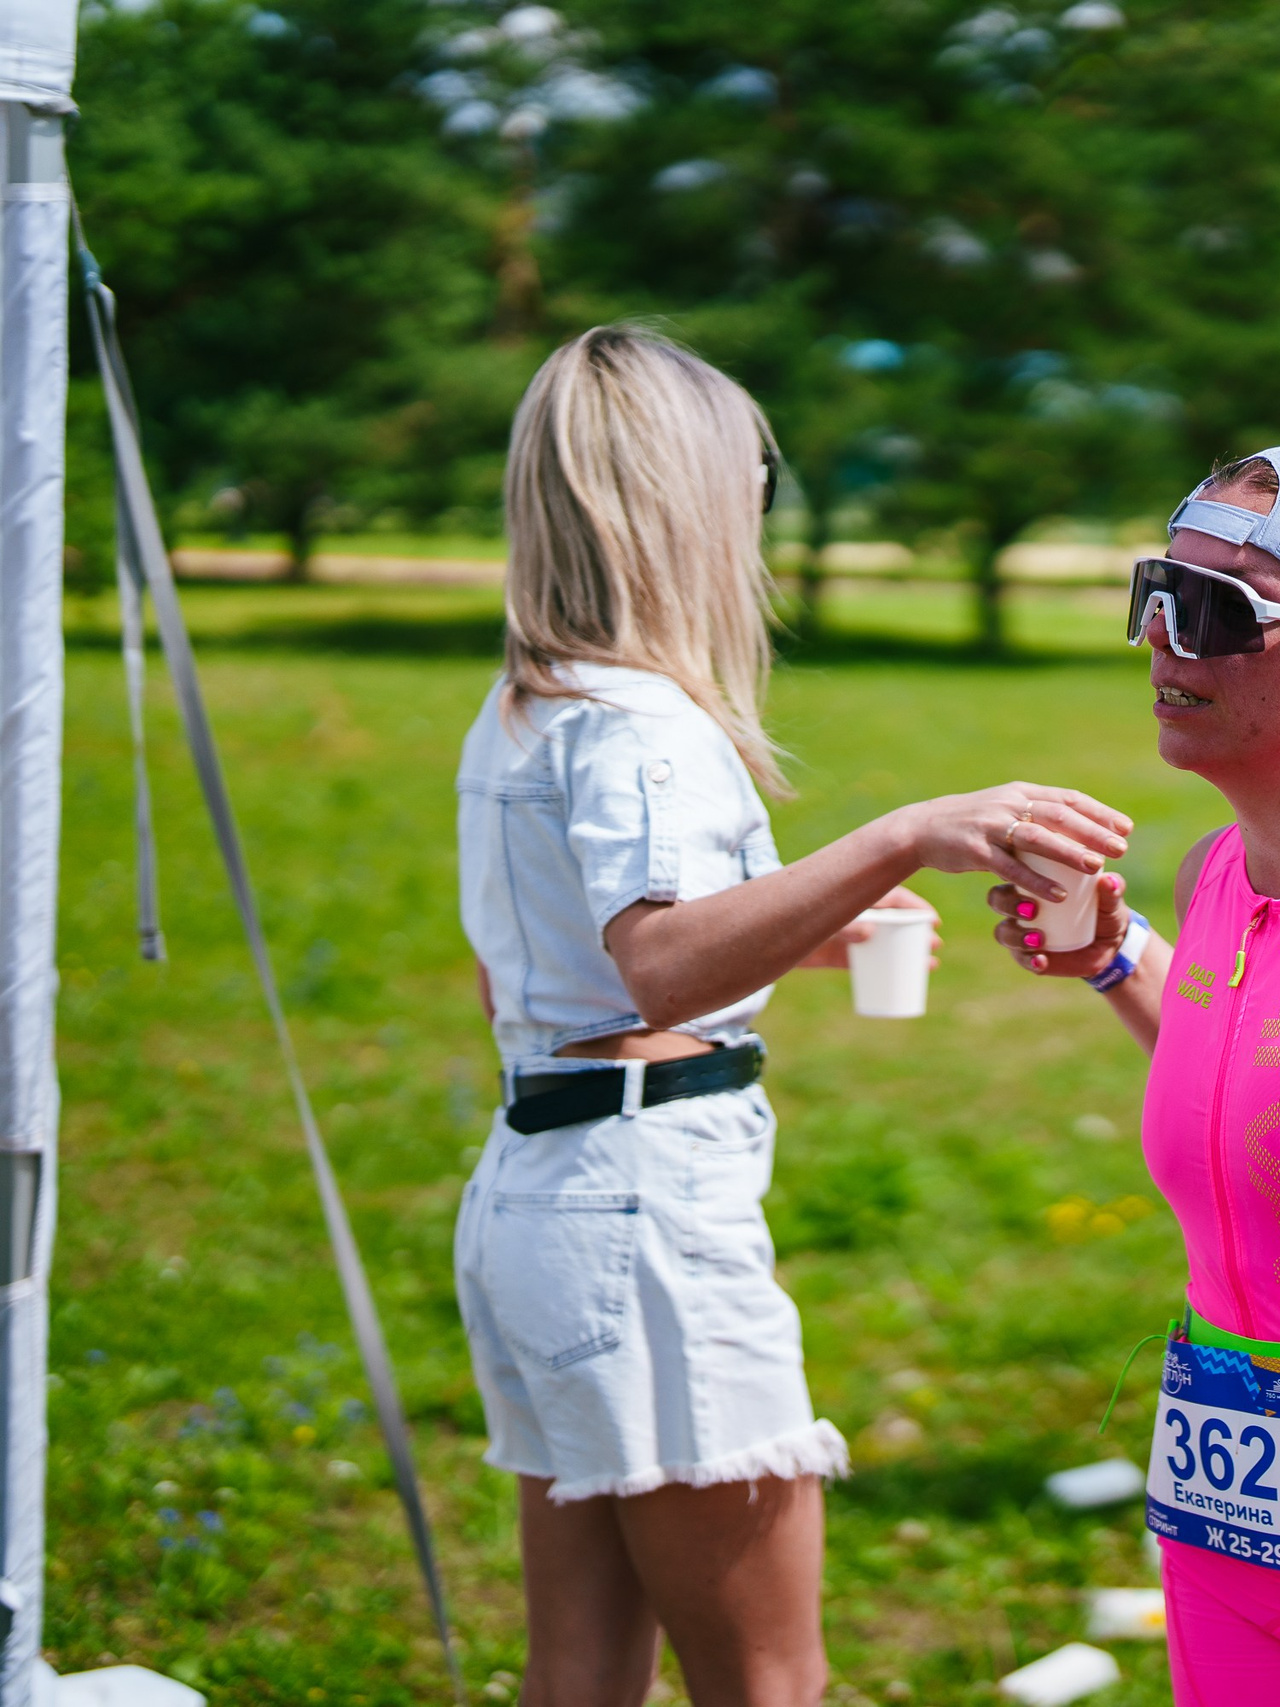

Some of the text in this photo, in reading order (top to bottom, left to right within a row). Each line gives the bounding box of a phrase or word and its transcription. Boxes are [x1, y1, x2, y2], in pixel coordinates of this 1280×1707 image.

[1186, 961, 1217, 988] MAD
[1176, 978, 1214, 1009] WAVE
[1165, 1407, 1279, 1502] 362
[1173, 1481, 1274, 1527] Екатерина
[1205, 1524, 1227, 1551] Ж
